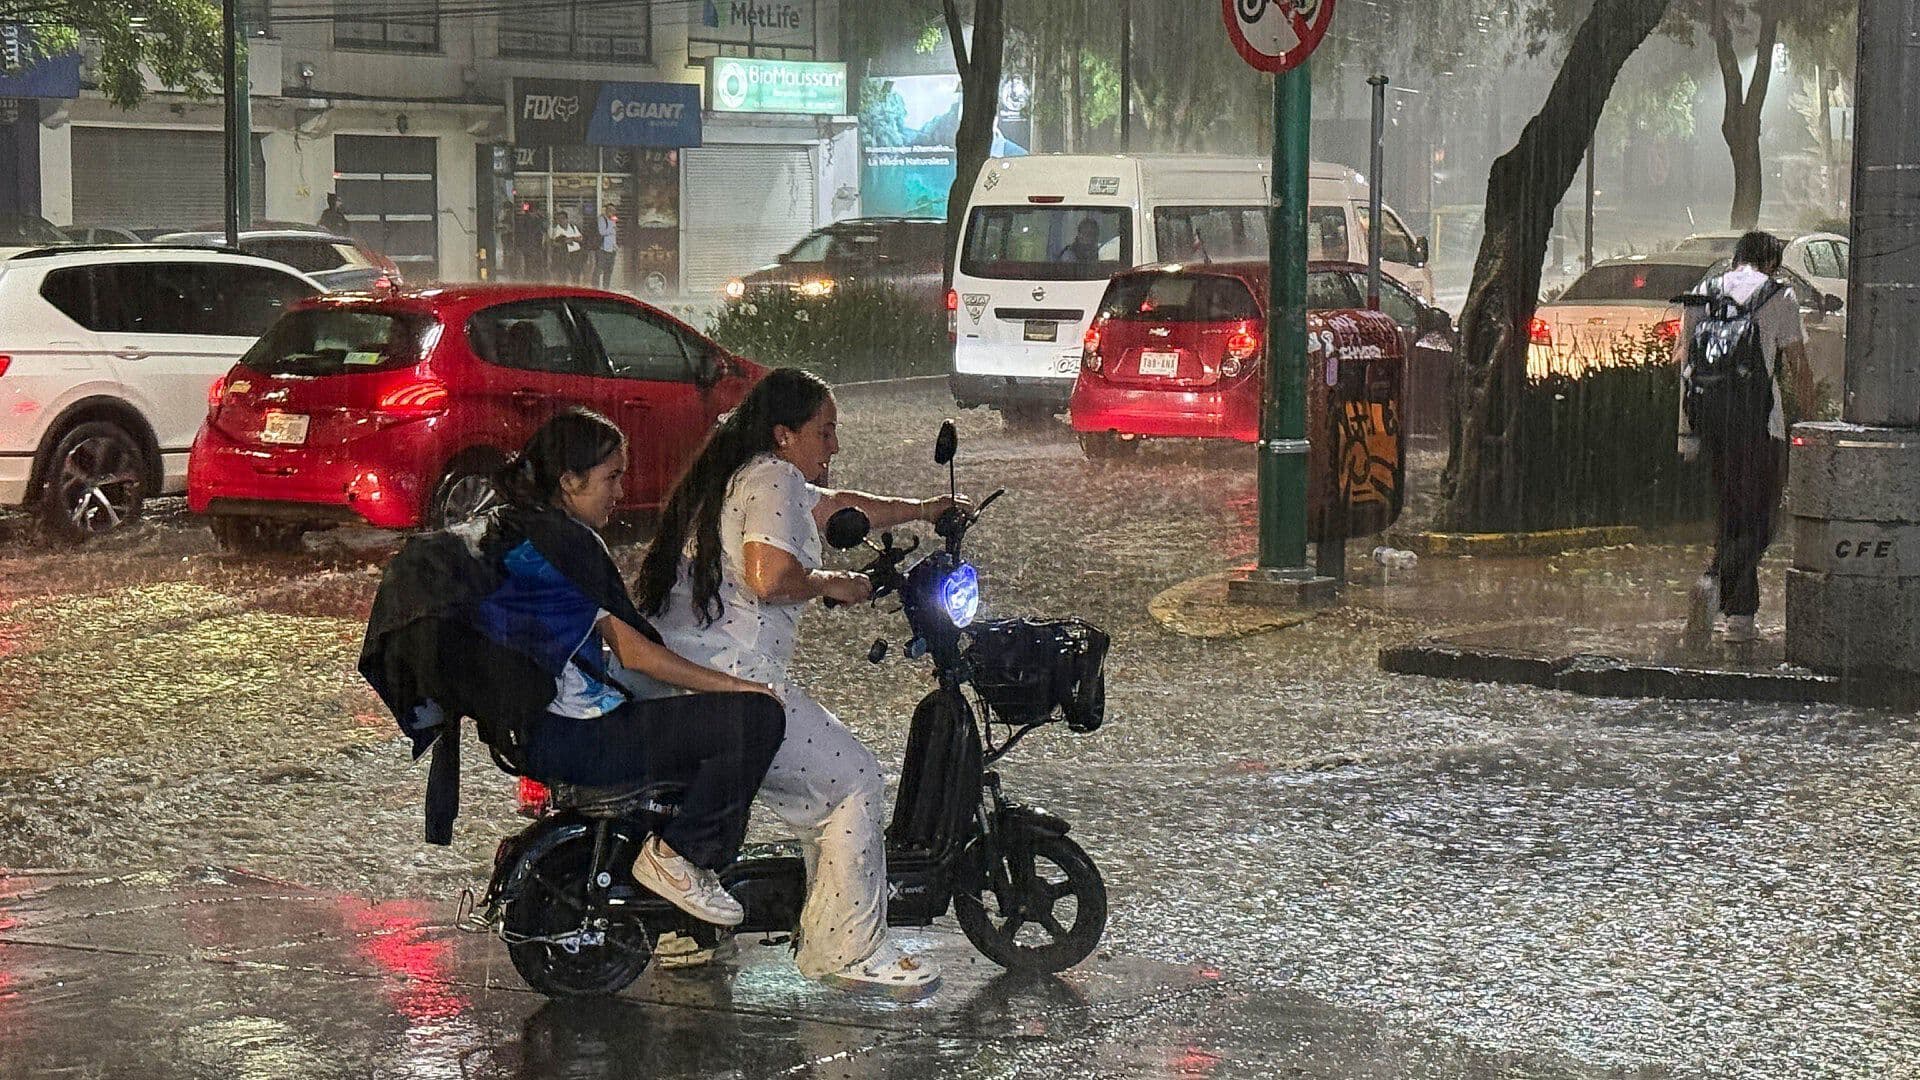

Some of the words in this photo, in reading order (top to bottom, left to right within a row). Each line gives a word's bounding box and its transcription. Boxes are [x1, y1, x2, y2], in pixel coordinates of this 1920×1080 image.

[731, 1, 800, 29] MetLife
[524, 94, 555, 120] FOX
[625, 101, 685, 120] GIANT
[879, 157, 904, 166] Madre
[906, 157, 950, 166] Naturaleza
[1836, 540, 1892, 559] CFE
